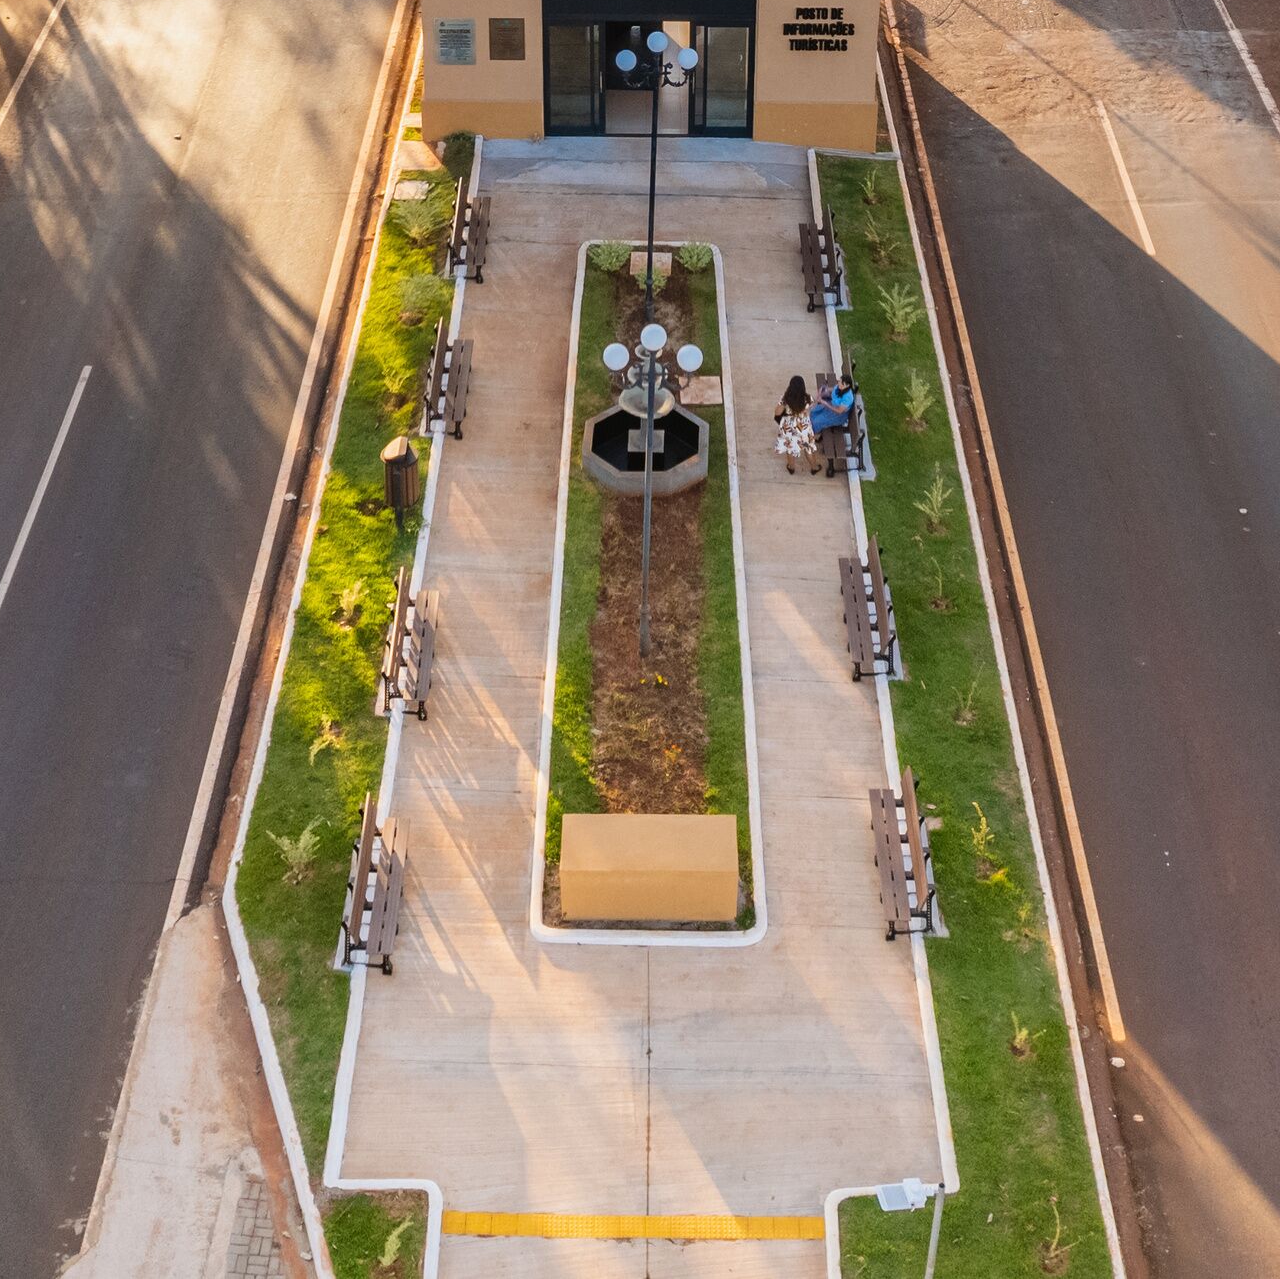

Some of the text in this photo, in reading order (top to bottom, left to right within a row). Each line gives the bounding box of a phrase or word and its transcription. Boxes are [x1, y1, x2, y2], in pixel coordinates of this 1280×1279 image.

[796, 8, 844, 20] POSTO DE
[783, 22, 855, 37] INFORMAÇÕES
[789, 38, 848, 51] TURÍSTICAS
